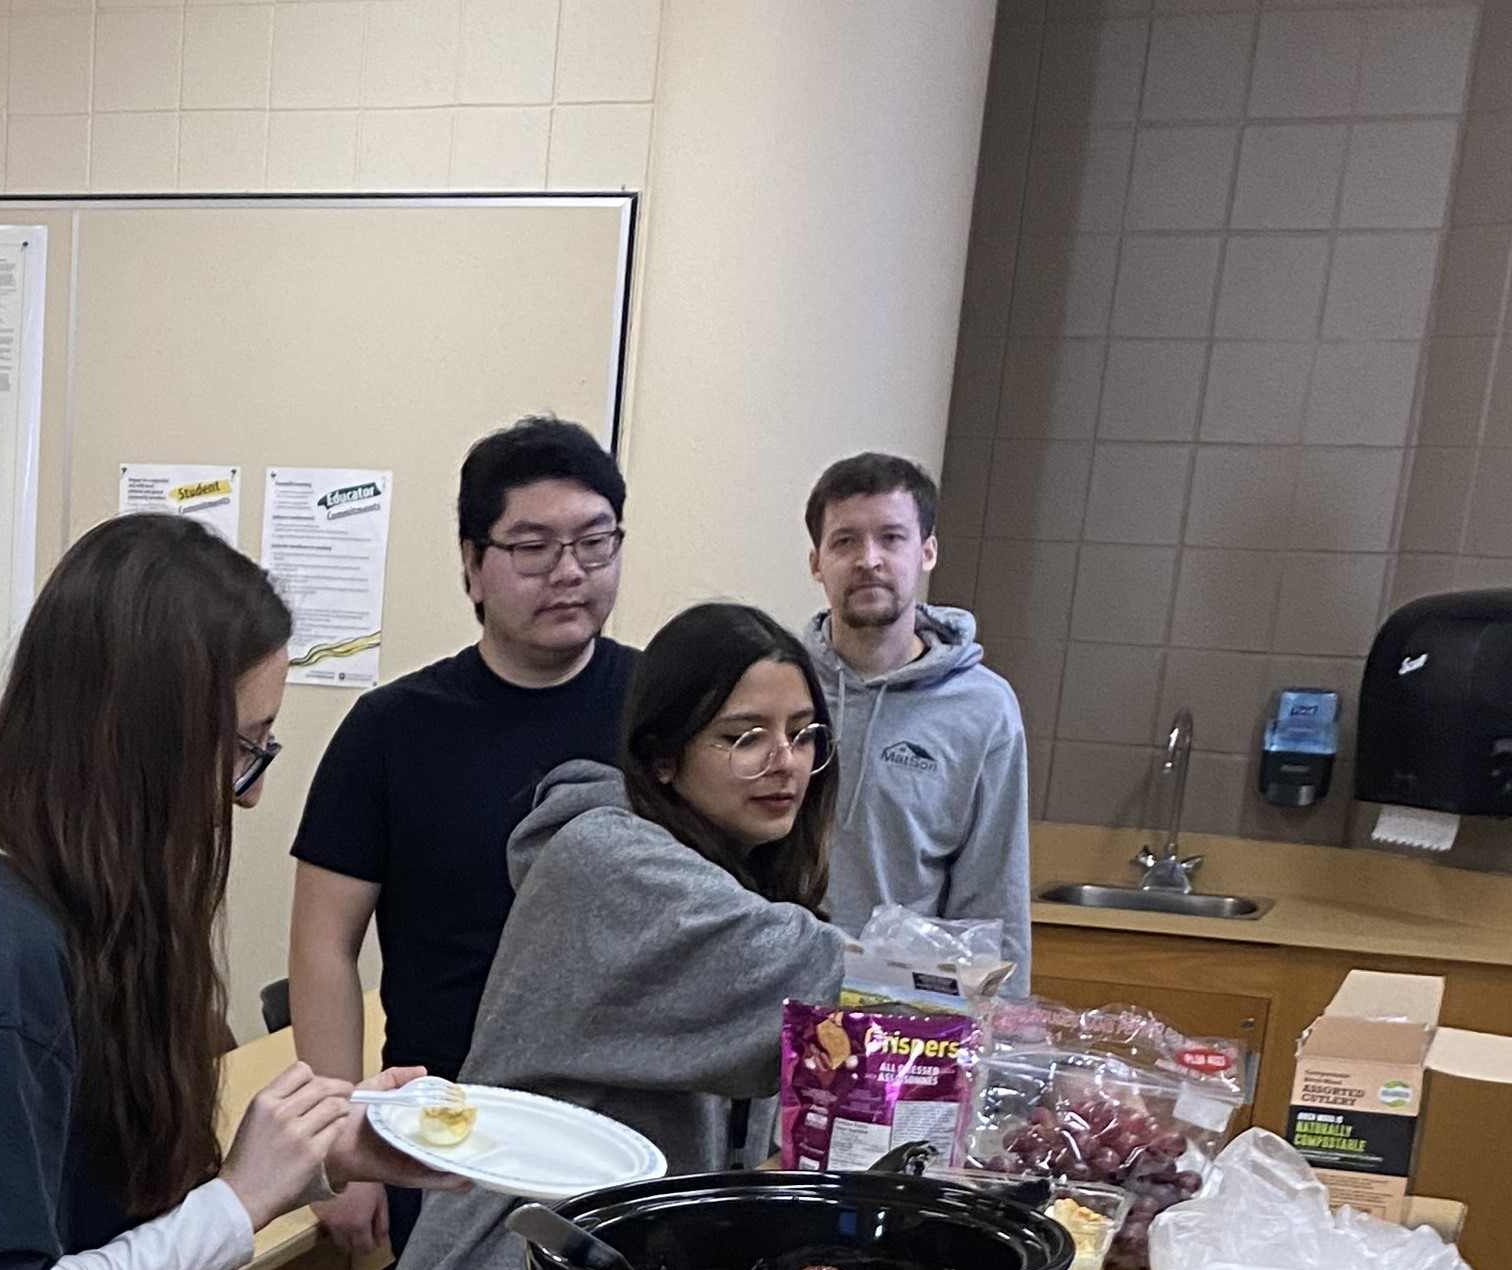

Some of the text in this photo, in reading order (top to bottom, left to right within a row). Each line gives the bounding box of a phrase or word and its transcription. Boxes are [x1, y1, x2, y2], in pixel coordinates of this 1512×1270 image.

[178, 480, 221, 500] Student
[327, 486, 375, 507] Educator
[1301, 1093, 1357, 1106] CUTLERY
[1302, 1084, 1366, 1098] ASSORTED
[1295, 1120, 1353, 1138] NATURALLY
[1294, 1133, 1369, 1153] COMPOSTABLE
